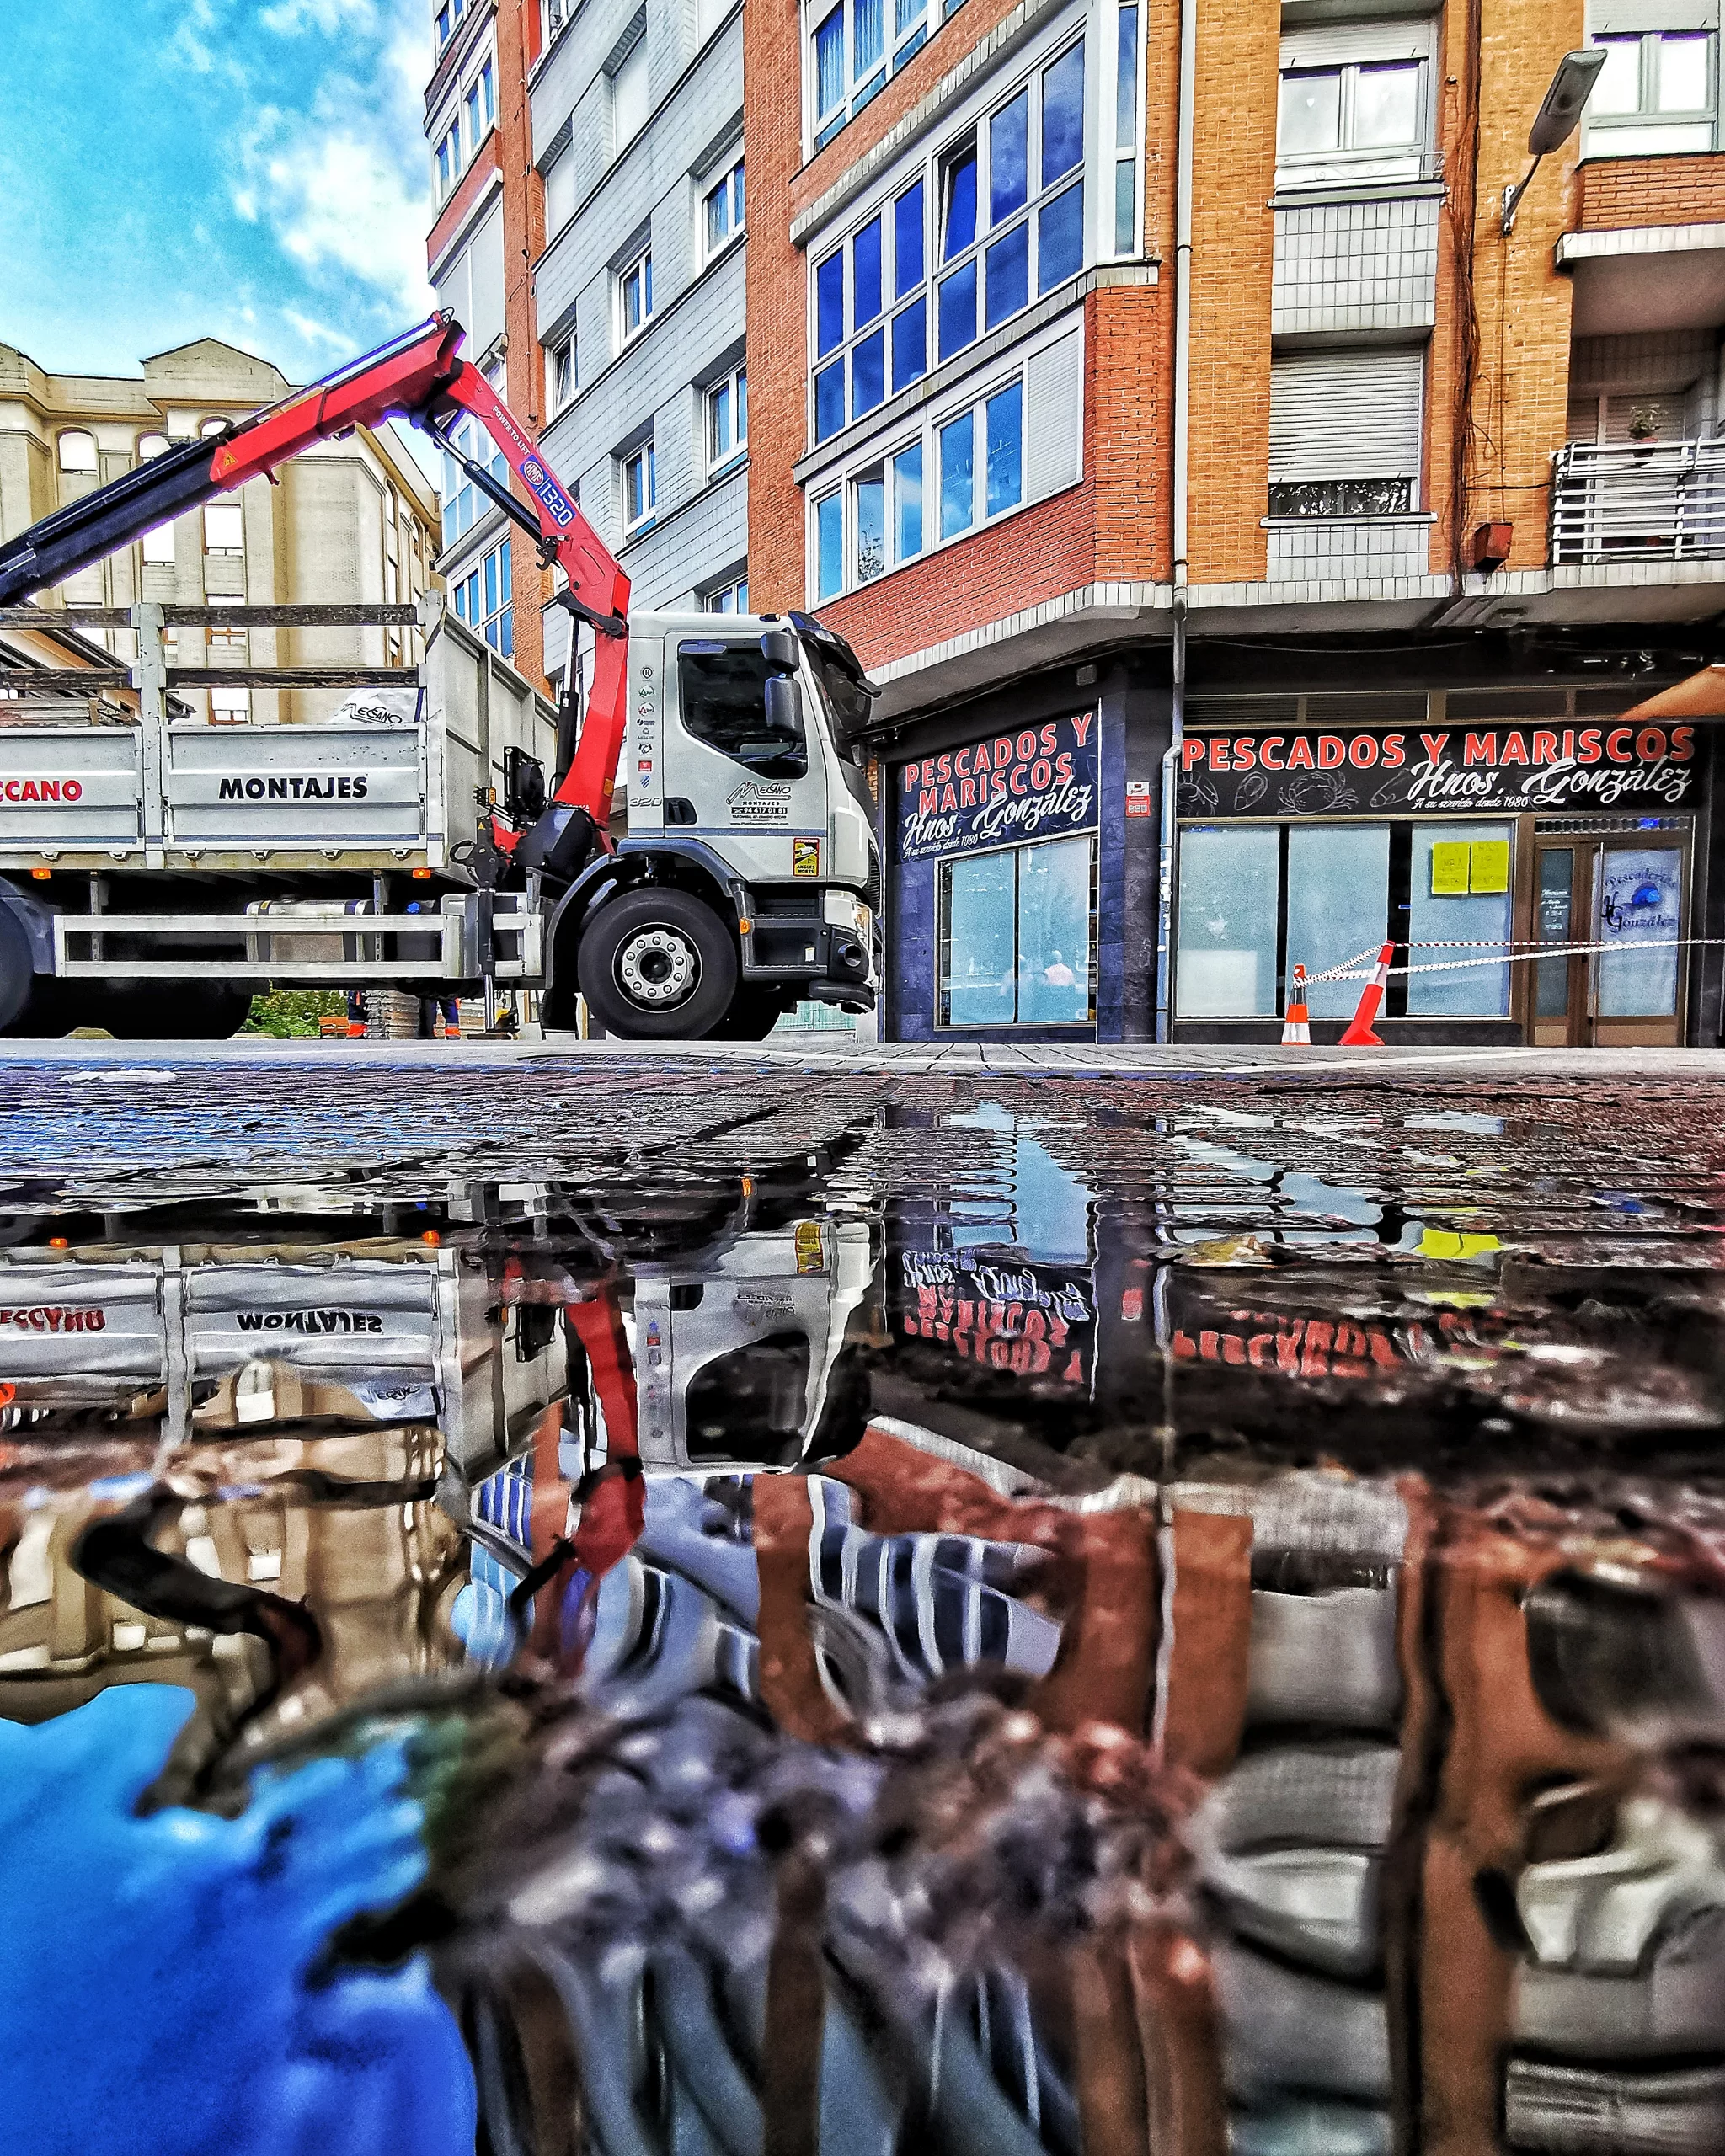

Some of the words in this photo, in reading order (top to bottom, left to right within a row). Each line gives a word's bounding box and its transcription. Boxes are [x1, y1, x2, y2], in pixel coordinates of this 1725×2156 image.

[493, 405, 513, 432] POWER
[516, 440, 531, 456] LIFT
[525, 462, 542, 483] HMF
[539, 483, 573, 526] 1320
[905, 724, 1056, 792] PESCADOS
[1071, 713, 1093, 747] Y
[1182, 734, 1406, 771] PESCADOS
[1421, 733, 1450, 766] Y
[1463, 727, 1695, 766] MARISCOS
[0, 780, 83, 802] CANO
[219, 776, 368, 799] MONTAJES
[919, 753, 1073, 817] MARISCOS
[1407, 760, 1503, 800] Hnos.
[1520, 756, 1693, 804] González
[629, 797, 662, 807] 320
[903, 807, 962, 850] Hnos.
[972, 775, 1093, 837] González
[1411, 798, 1425, 809] A
[1425, 800, 1437, 808] su
[1438, 798, 1473, 808] servicio
[1475, 796, 1502, 808] desde
[1503, 796, 1529, 808] 1980
[961, 834, 979, 846] 1980
